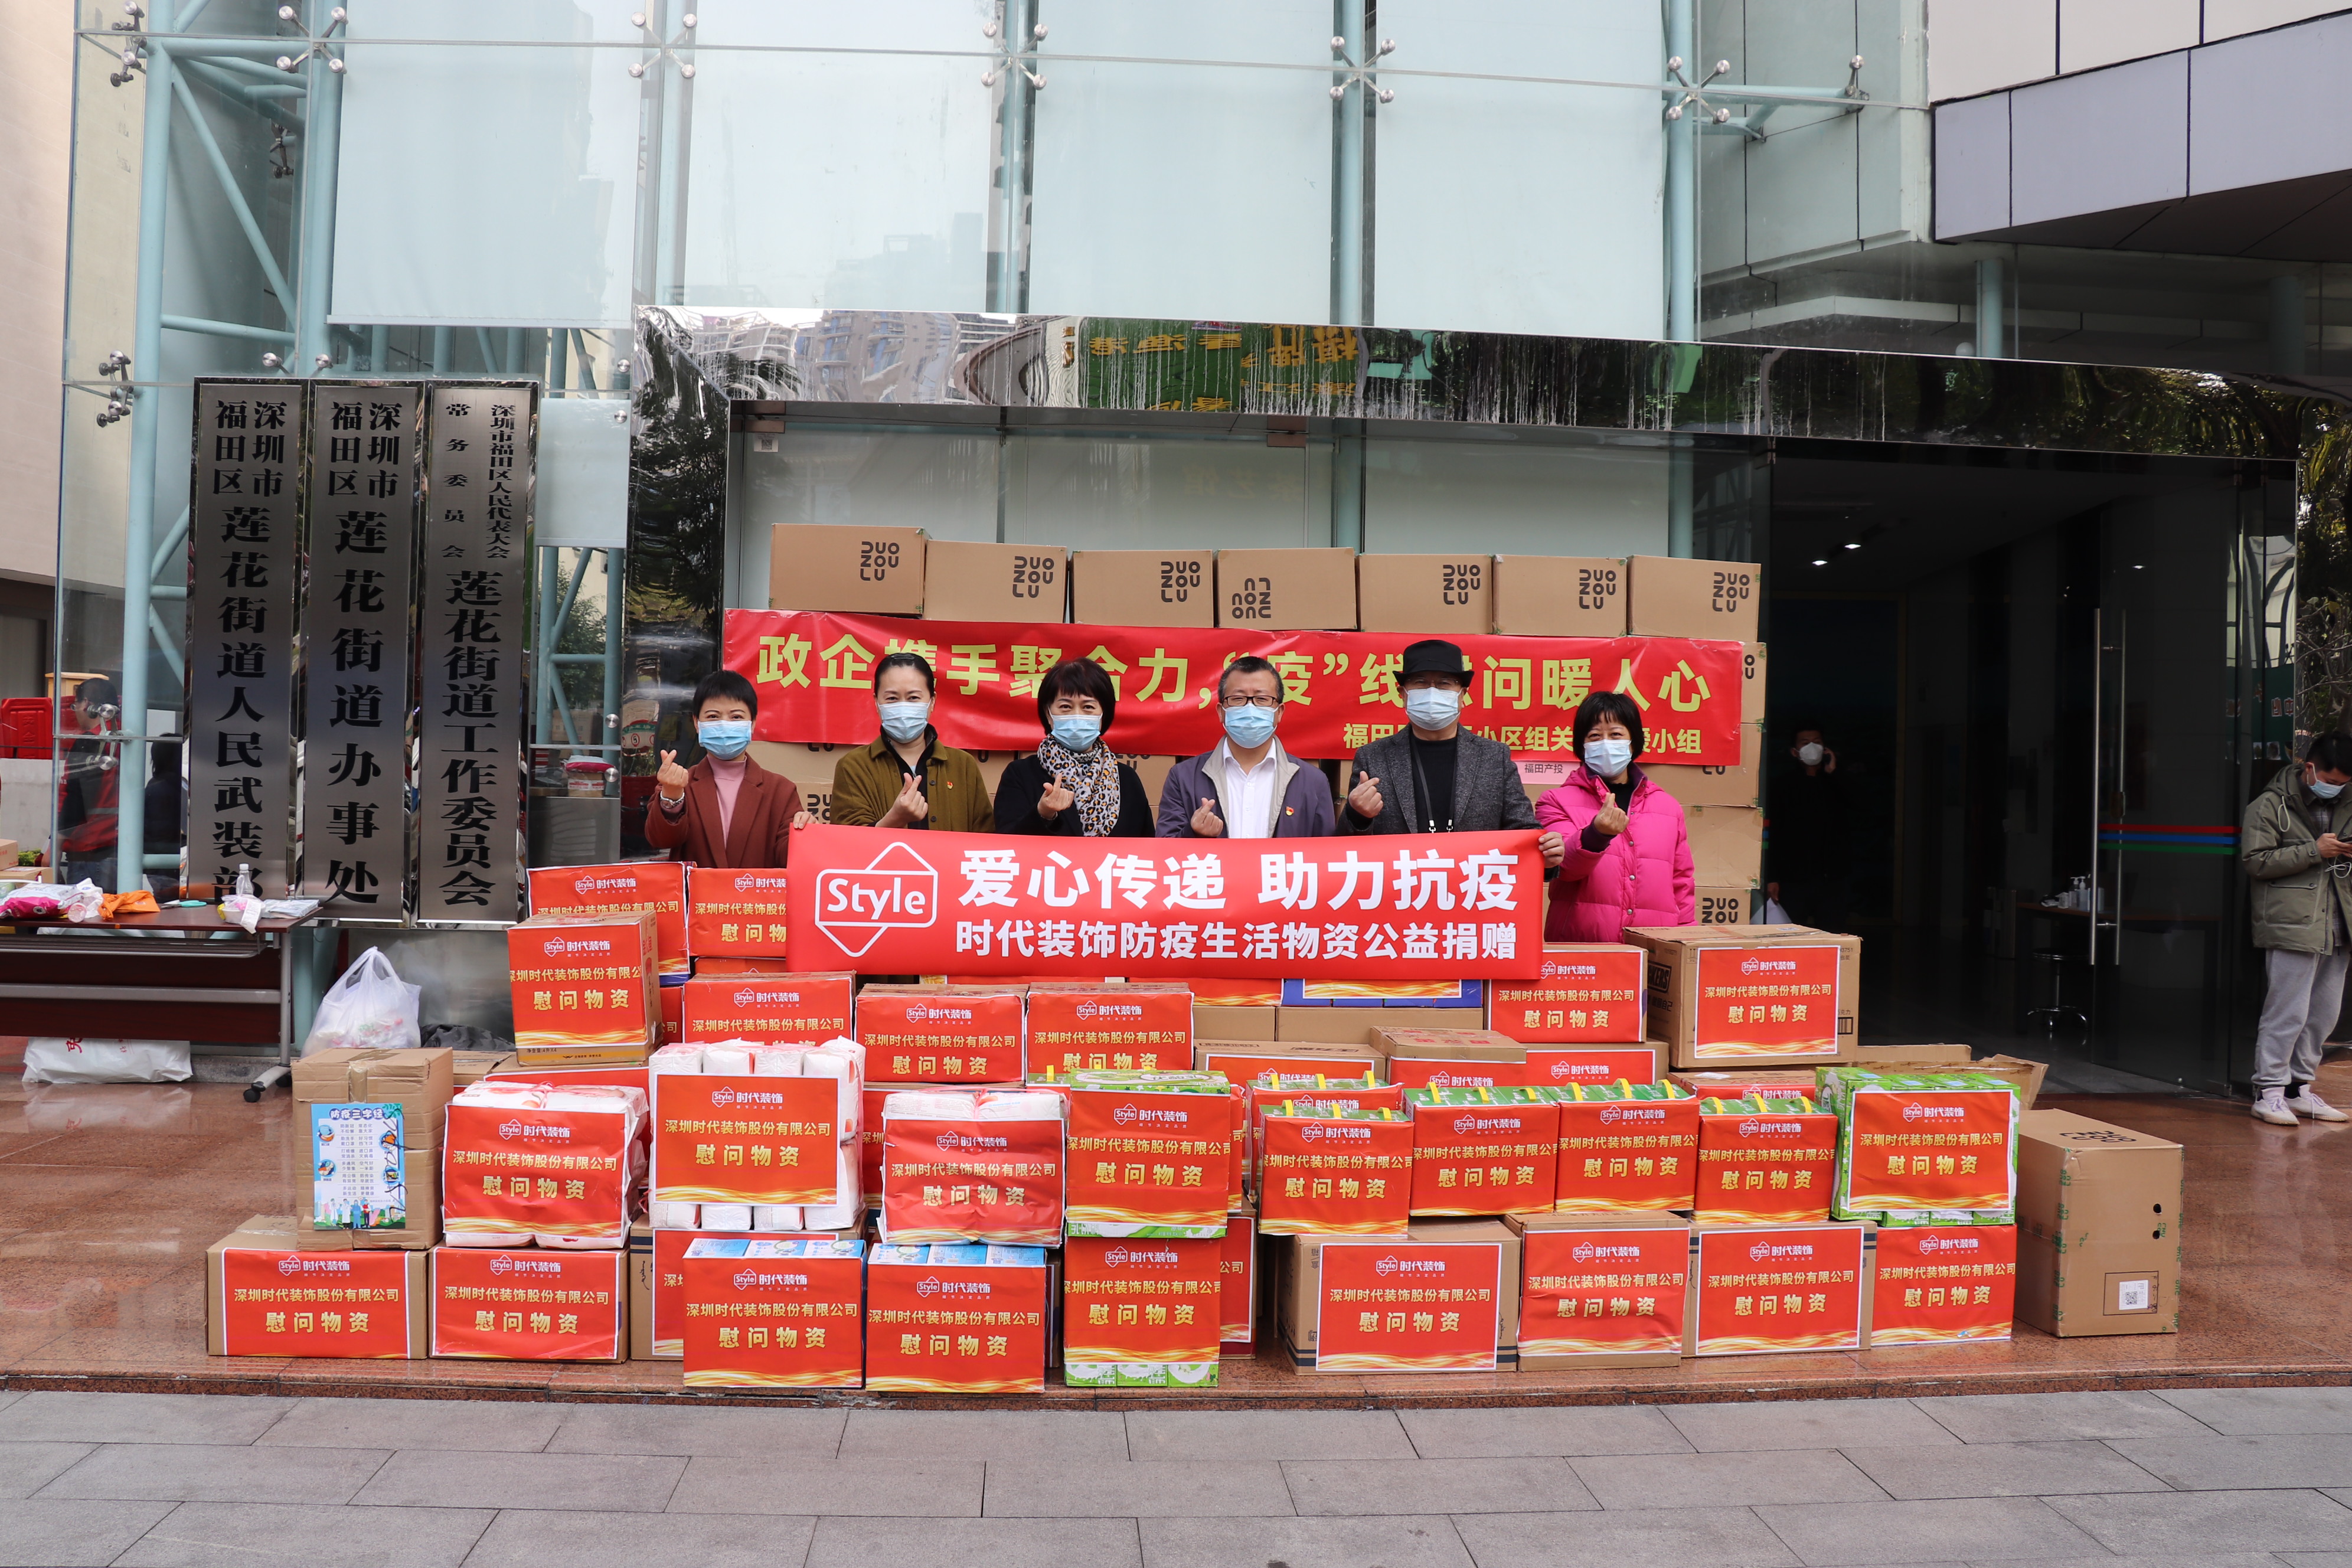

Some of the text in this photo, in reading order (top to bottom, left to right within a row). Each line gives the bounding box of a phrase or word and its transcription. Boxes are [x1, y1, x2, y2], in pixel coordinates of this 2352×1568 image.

[213, 400, 247, 494] 福田区
[252, 401, 286, 496] 深圳市
[328, 402, 362, 496] 福田区
[367, 403, 401, 498] 深圳市
[442, 404, 468, 558] 常务委员会
[486, 409, 514, 558] 深圳市福田区人民代表大会
[323, 511, 387, 907] 莲花街道办事处
[439, 571, 502, 905] 莲花街道工作委员会
[1525, 764, 1564, 773] 福田产投
[577, 878, 636, 889] Style 时代装饰
[737, 878, 752, 887] Style
[958, 848, 1518, 910] 爱心传递 助力抗疫
[827, 877, 926, 920] Style
[546, 940, 610, 951] Style 时代装饰
[957, 919, 1515, 959] 时代装饰防疫生活物资公益捐赠
[1558, 966, 1595, 974] 时代装饰
[1760, 961, 1795, 970] 时代装饰
[736, 992, 799, 1002] Style 时代装饰
[1499, 990, 1634, 1001] 深圳时代装饰股份有限公司
[1705, 984, 1831, 998] 深圳时代装饰股份有限公司
[534, 989, 628, 1010] 慰问物资
[909, 1009, 971, 1018] Style 时代装饰
[1079, 1005, 1141, 1015] Style 时代装饰
[1729, 1004, 1807, 1023] 慰问物资
[692, 1018, 844, 1032] 深圳时代装饰股份有限公司
[1524, 1010, 1608, 1028] 慰问物资
[863, 1034, 1015, 1048] 深圳时代装饰股份有限公司
[1035, 1031, 1185, 1044] 深圳时代装饰股份有限公司
[893, 1056, 986, 1075] 慰问物资
[1572, 1066, 1609, 1074] 时代装饰
[1452, 1076, 1494, 1087] 时代装饰
[714, 1092, 783, 1103] Style 时代装饰
[330, 1109, 384, 1119] 防疫三字经
[1116, 1110, 1187, 1122] Style 时代装饰
[1601, 1110, 1665, 1119] Style 时代装饰
[1905, 1108, 1964, 1117] Style 时代装饰
[501, 1125, 570, 1137] Style 时代装饰
[665, 1120, 830, 1136] 深圳时代装饰股份有限公司
[1456, 1119, 1520, 1129] Style 时代装饰
[1740, 1123, 1801, 1132] Style 时代装饰
[1304, 1128, 1370, 1138] Style 时代装饰
[1861, 1133, 2003, 1146] 深圳时代装饰股份有限公司
[939, 1137, 1007, 1146] Style 时代装饰
[1560, 1135, 1697, 1149] 深圳时代装饰股份有限公
[453, 1148, 618, 1171] 深圳时代装饰股份有限公司
[695, 1144, 799, 1167] 慰问物资
[891, 1161, 1055, 1177] 深圳时代装饰股份有限公司
[1584, 1157, 1678, 1177] 慰问物资
[1887, 1155, 1977, 1175] 慰问物资
[1096, 1162, 1202, 1186] 慰问物资
[1438, 1167, 1534, 1187] 慰问物资
[1721, 1170, 1812, 1190] 慰问物资
[483, 1176, 584, 1201] 慰问物资
[920, 1185, 1024, 1207] 慰问物资
[1285, 1178, 1386, 1198] 慰问物资
[1574, 1246, 1639, 1257] Style 时代装饰
[1752, 1245, 1812, 1256] Style 时代装饰
[1922, 1239, 1978, 1249] Style 时代装饰
[1108, 1250, 1177, 1262] Style 时代装饰
[280, 1261, 349, 1270] Style 时代装饰
[492, 1260, 560, 1272] Style 时代装饰
[1378, 1261, 1445, 1271] Style 时代装饰
[1880, 1263, 2015, 1280] 深圳时代装饰股份有限公司
[736, 1275, 807, 1285] Style 时代装饰
[1528, 1273, 1683, 1289] 深圳时代装饰股份有限公司
[1709, 1270, 1853, 1288] 深圳时代装饰股份有限公司
[234, 1288, 398, 1302] 深圳时代装饰股份有限公司
[445, 1286, 608, 1305] 深圳时代装饰股份有限公司
[919, 1282, 990, 1293] Style 时代装饰
[1330, 1289, 1490, 1302] 深圳时代装饰股份有限公司
[1735, 1293, 1826, 1315] 慰问物资
[1905, 1286, 1990, 1306] 慰问物资
[687, 1303, 857, 1317] 深圳时代装饰股份有限公司
[1089, 1304, 1194, 1325] 慰问物资
[1557, 1298, 1655, 1317] 慰问物资
[266, 1312, 368, 1332] 慰问物资
[475, 1311, 577, 1334] 慰问物资
[869, 1309, 1039, 1325] 深圳时代装饰股份有限公司
[1359, 1312, 1459, 1332] 慰问物资
[719, 1327, 825, 1348] 慰问物资
[900, 1334, 1007, 1356] 慰问物资
